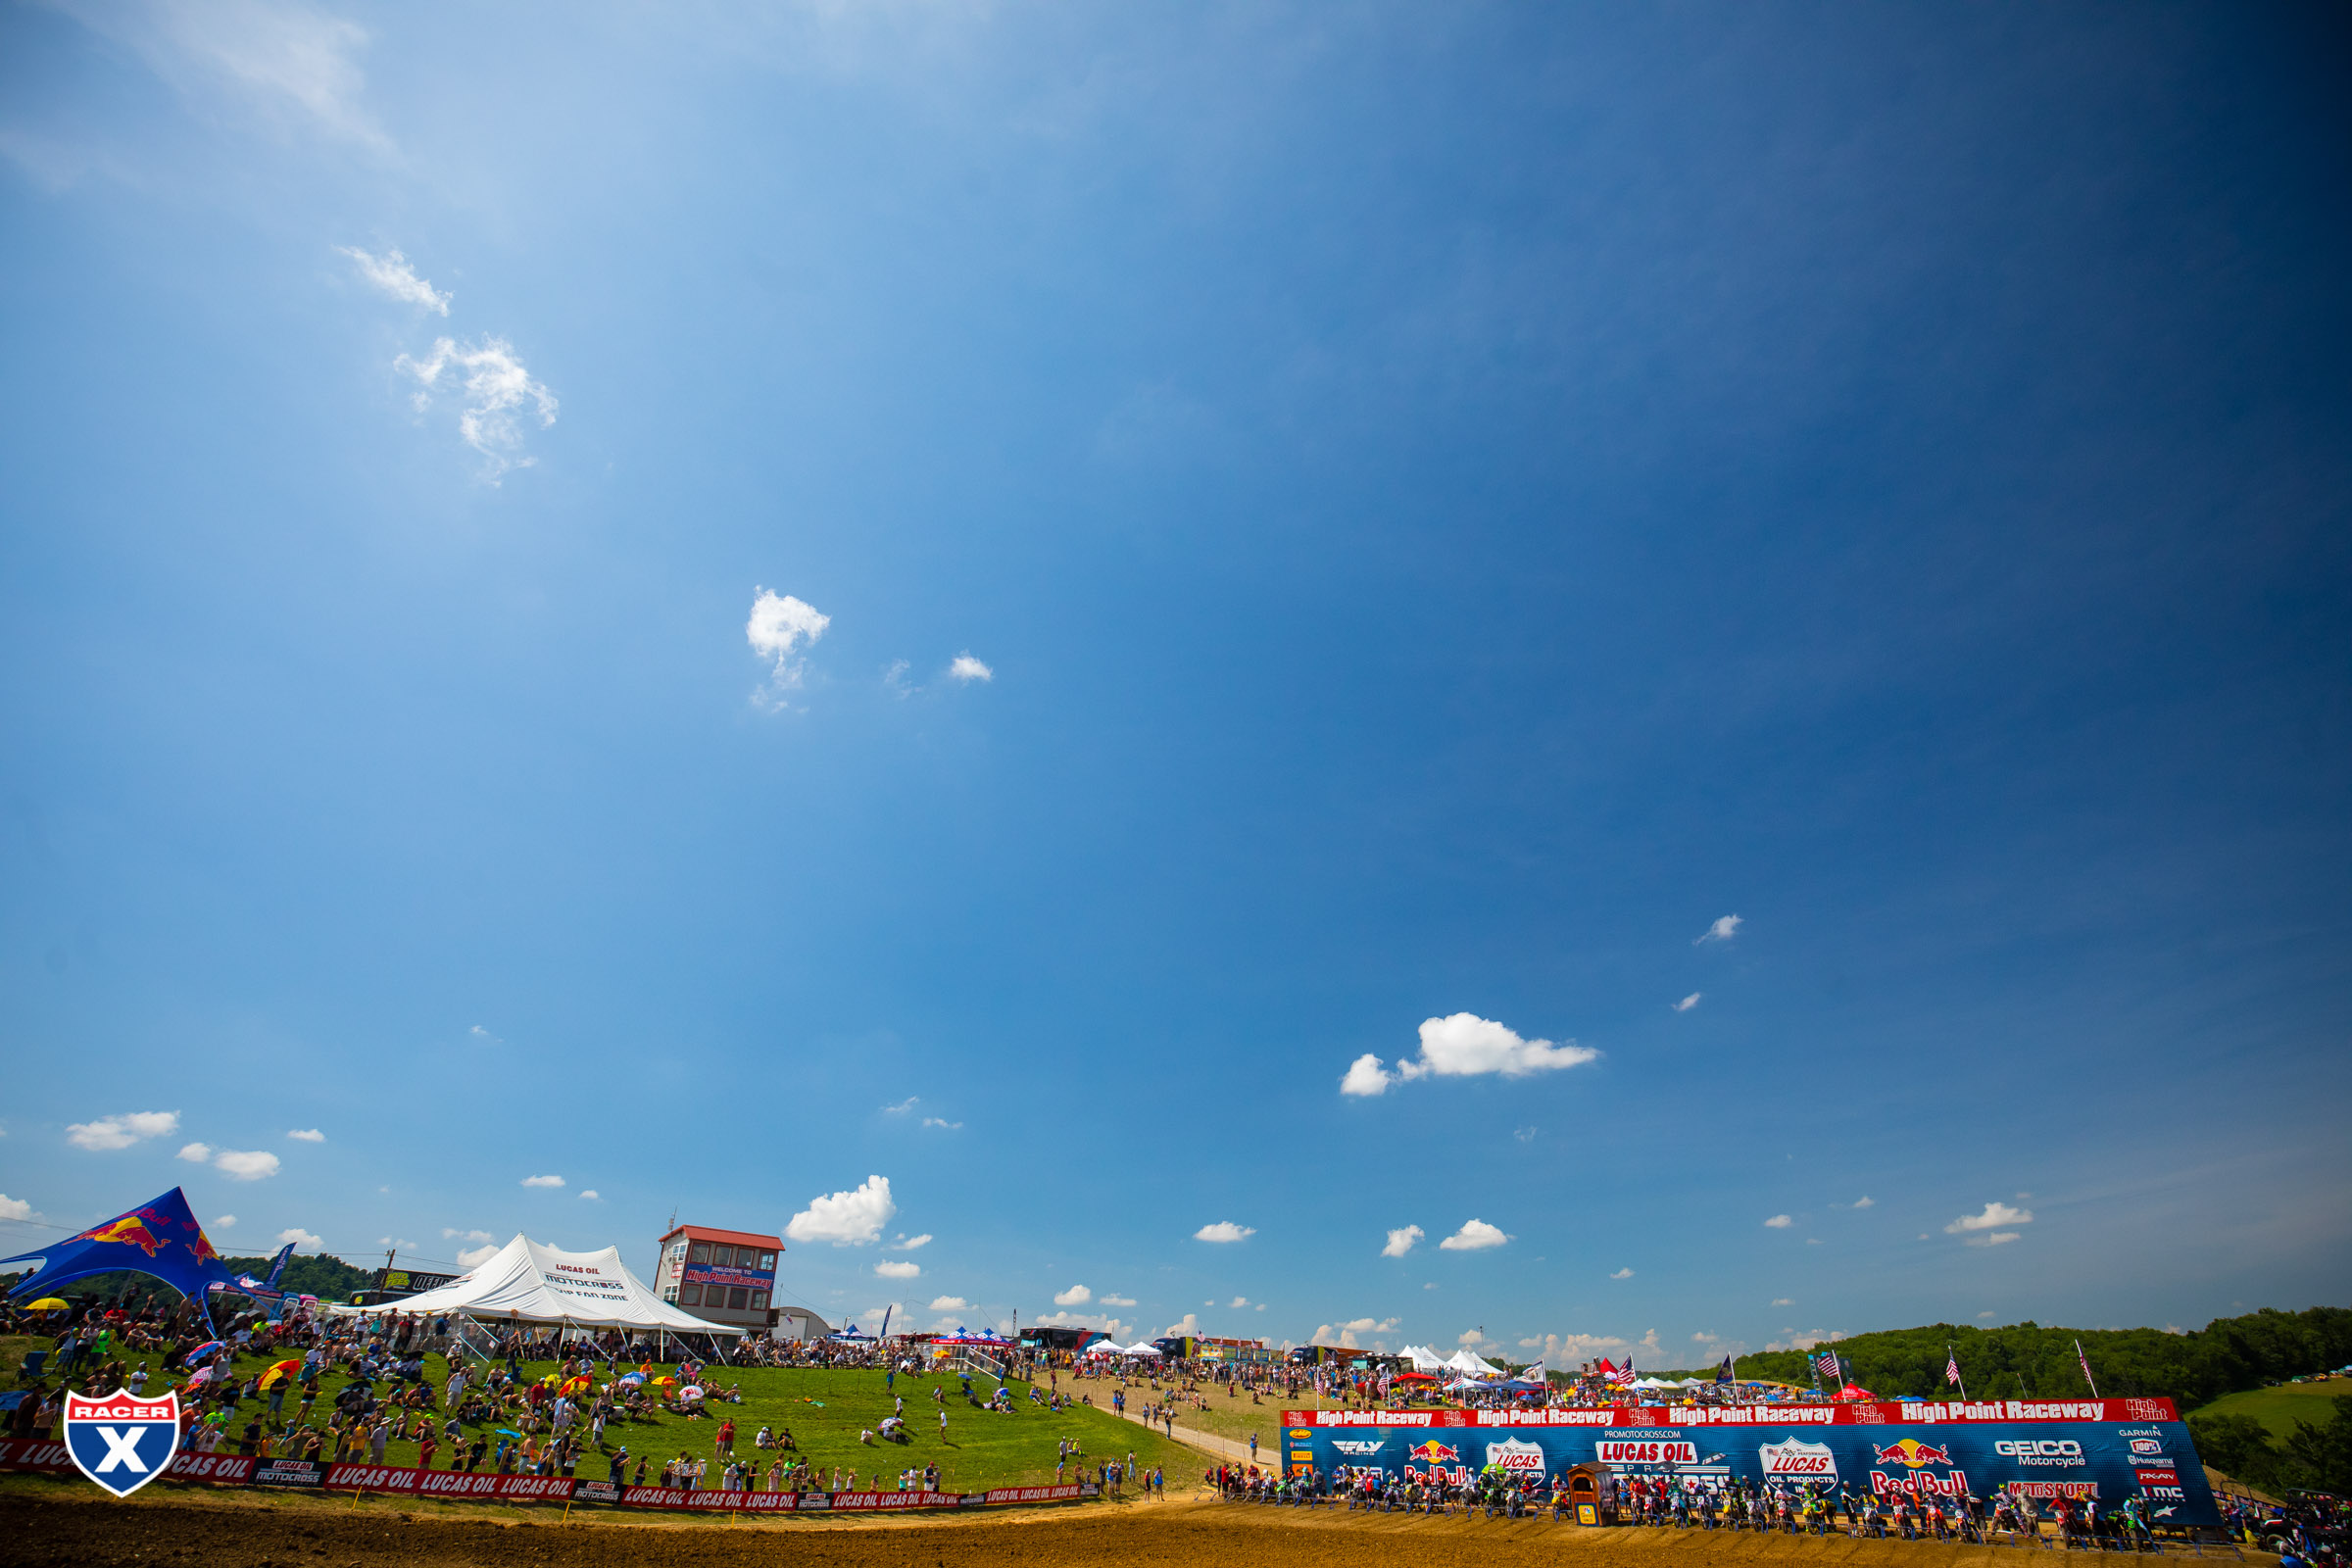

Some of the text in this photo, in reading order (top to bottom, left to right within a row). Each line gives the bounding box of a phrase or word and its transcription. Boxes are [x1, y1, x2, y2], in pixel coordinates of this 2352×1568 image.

[139, 1206, 172, 1227] Bull
[556, 1263, 584, 1274] LUCAS
[711, 1266, 743, 1275] WELCOME
[384, 1278, 410, 1289] TEES
[545, 1274, 624, 1290] MOTOCROSS
[687, 1269, 708, 1283] High
[709, 1271, 733, 1284] Point
[733, 1274, 773, 1289] Raceway
[600, 1293, 629, 1301] ZONE
[1852, 1404, 1878, 1415] High
[2126, 1399, 2157, 1410] High
[1288, 1411, 1302, 1420] High
[1444, 1410, 1461, 1420] High
[1629, 1408, 1649, 1418] High
[1669, 1405, 1836, 1426] High Point Raceway
[1901, 1400, 2105, 1423] High Point Raceway
[2131, 1408, 2169, 1420] Point
[1290, 1418, 1306, 1427] Point
[1315, 1411, 1433, 1427] High Point Raceway
[1446, 1418, 1466, 1427] Point
[1477, 1408, 1615, 1427] High Point Raceway
[1631, 1415, 1656, 1426] Point
[1856, 1413, 1886, 1424] Point
[1604, 1430, 1682, 1439] PROMOTOCROSS.COM
[2119, 1425, 2162, 1437] GARMIN
[1332, 1441, 1386, 1452] FLY
[1994, 1440, 2082, 1456] GEICO
[2134, 1443, 2157, 1451] 100%
[1601, 1443, 1693, 1462] LUCAS OIL
[274, 1460, 299, 1469] LUCAS
[1496, 1454, 1540, 1468] LUCAS
[1772, 1457, 1830, 1472] LUCAS
[2019, 1456, 2085, 1469] Motorcycle
[215, 1458, 249, 1478] OIL
[256, 1472, 320, 1482] MOTOCROSS
[327, 1467, 571, 1495] LUCAS OIL LUCAS OIL LUCAS OIL
[1870, 1470, 1970, 1497] Red Bull
[574, 1491, 619, 1499] MOTOCROSS
[987, 1491, 1008, 1501] LUCAS
[1008, 1490, 1019, 1500] OIL
[1020, 1490, 1041, 1500] LUCAS
[1040, 1489, 1050, 1498] OIL
[1052, 1488, 1070, 1497] LUCAS
[1069, 1486, 1078, 1495] OIL
[2140, 1486, 2185, 1497] KMC
[624, 1489, 796, 1507] LUCAS OIL LUCAS OIL LUCAS OIL
[834, 1494, 959, 1506] LUCAS OIL LUCAS OIL LUCAS OIL
